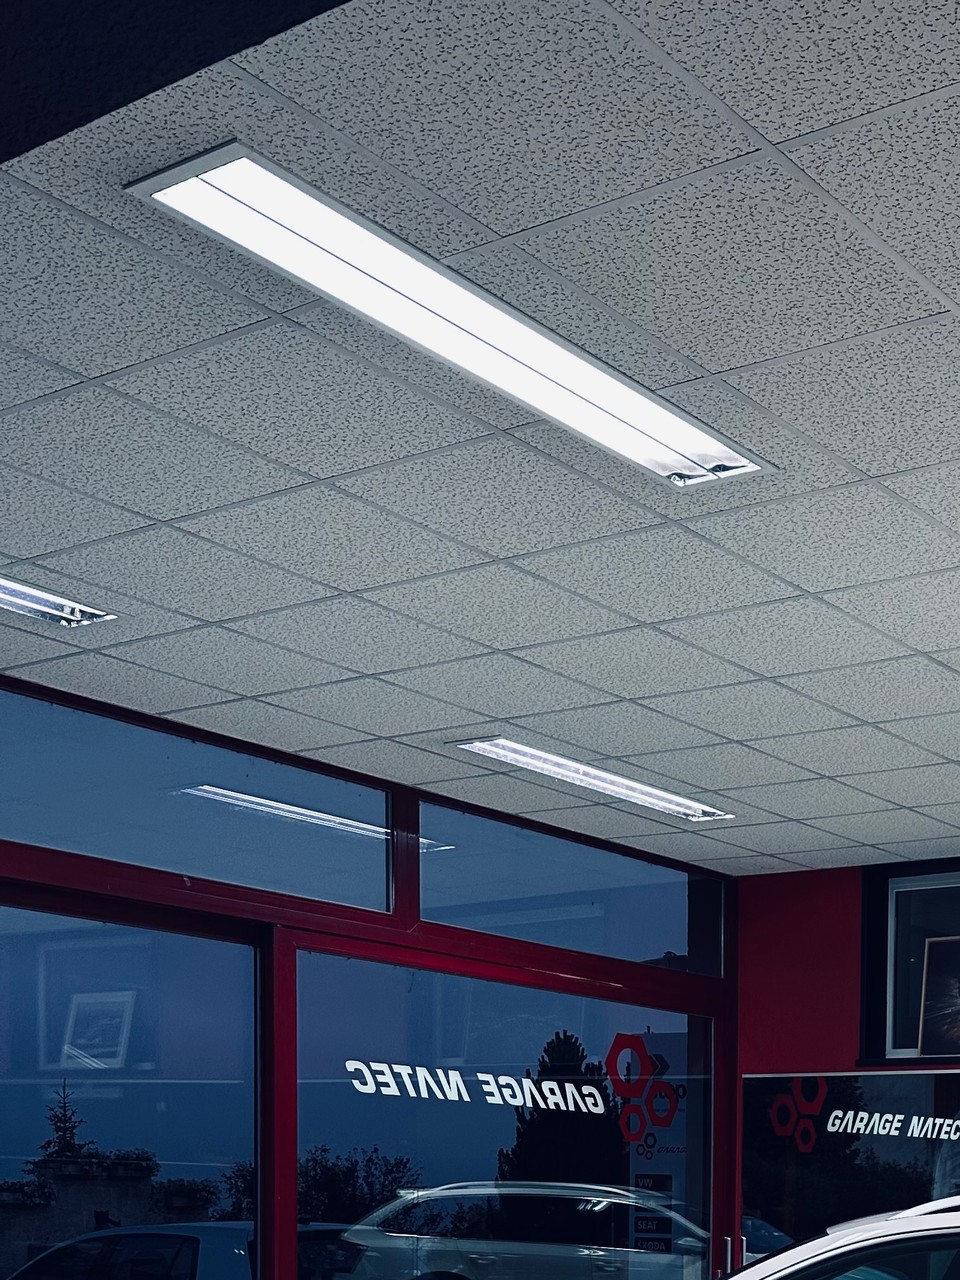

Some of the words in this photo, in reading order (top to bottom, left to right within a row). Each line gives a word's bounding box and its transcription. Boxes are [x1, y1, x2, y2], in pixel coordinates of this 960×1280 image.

[826, 1109, 905, 1136] GARAGE
[637, 1178, 653, 1187] VW
[637, 1220, 658, 1231] SEAT
